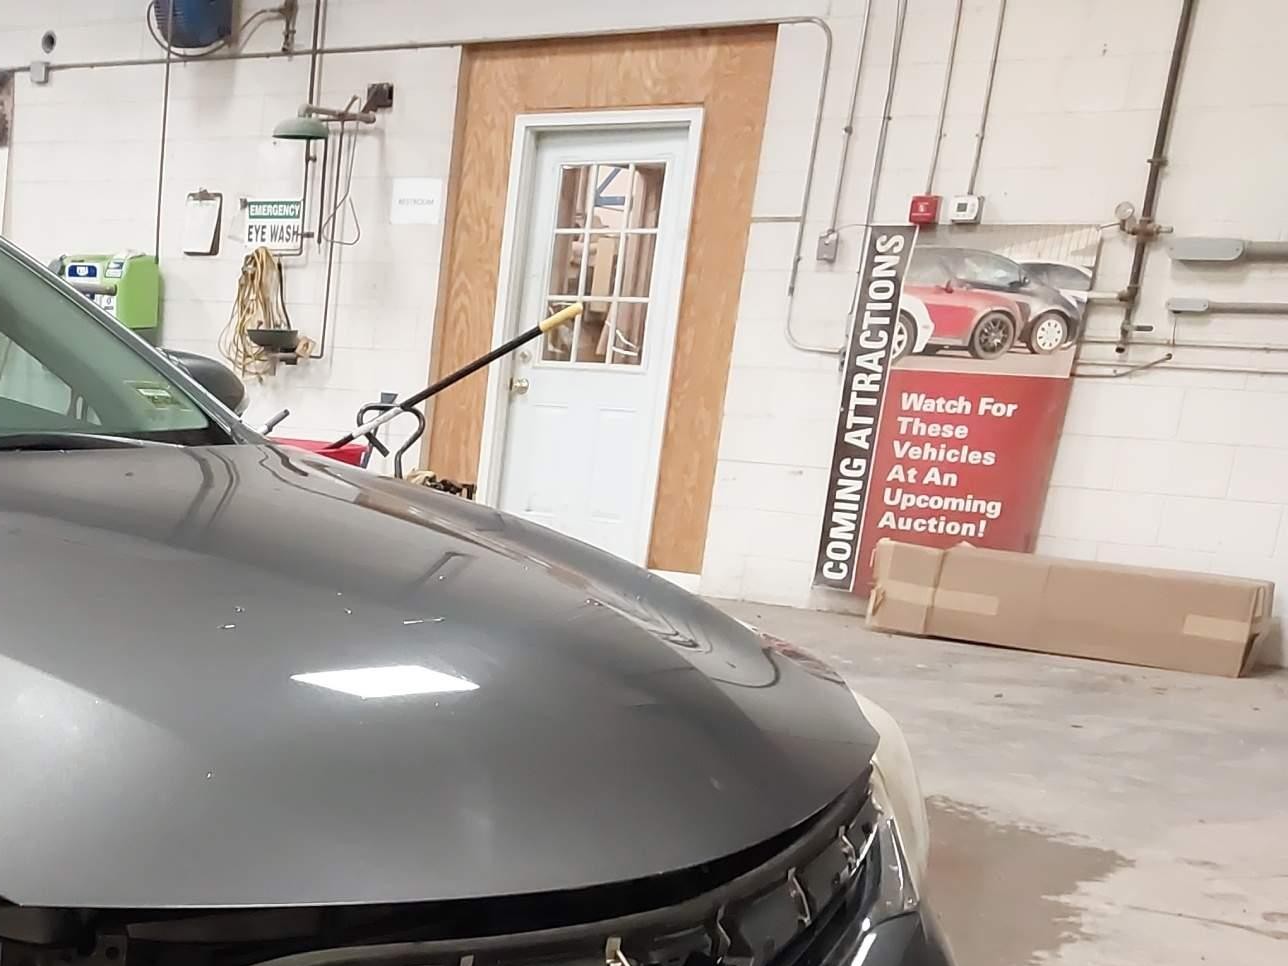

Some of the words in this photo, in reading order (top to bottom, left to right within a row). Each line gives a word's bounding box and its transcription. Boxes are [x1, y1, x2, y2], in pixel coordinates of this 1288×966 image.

[249, 204, 300, 217] EMERGENCY
[247, 224, 266, 243] EYE
[269, 224, 300, 243] WASH
[822, 457, 866, 580] COMING
[844, 234, 905, 449] ATTRACTIONS
[900, 392, 972, 415] Watch
[978, 397, 1018, 417] For
[897, 417, 968, 439] These
[892, 441, 996, 465] Vehicles
[886, 464, 917, 485] At
[922, 466, 958, 487] An
[883, 488, 1002, 519] Upcoming
[877, 510, 987, 538] Auction!
